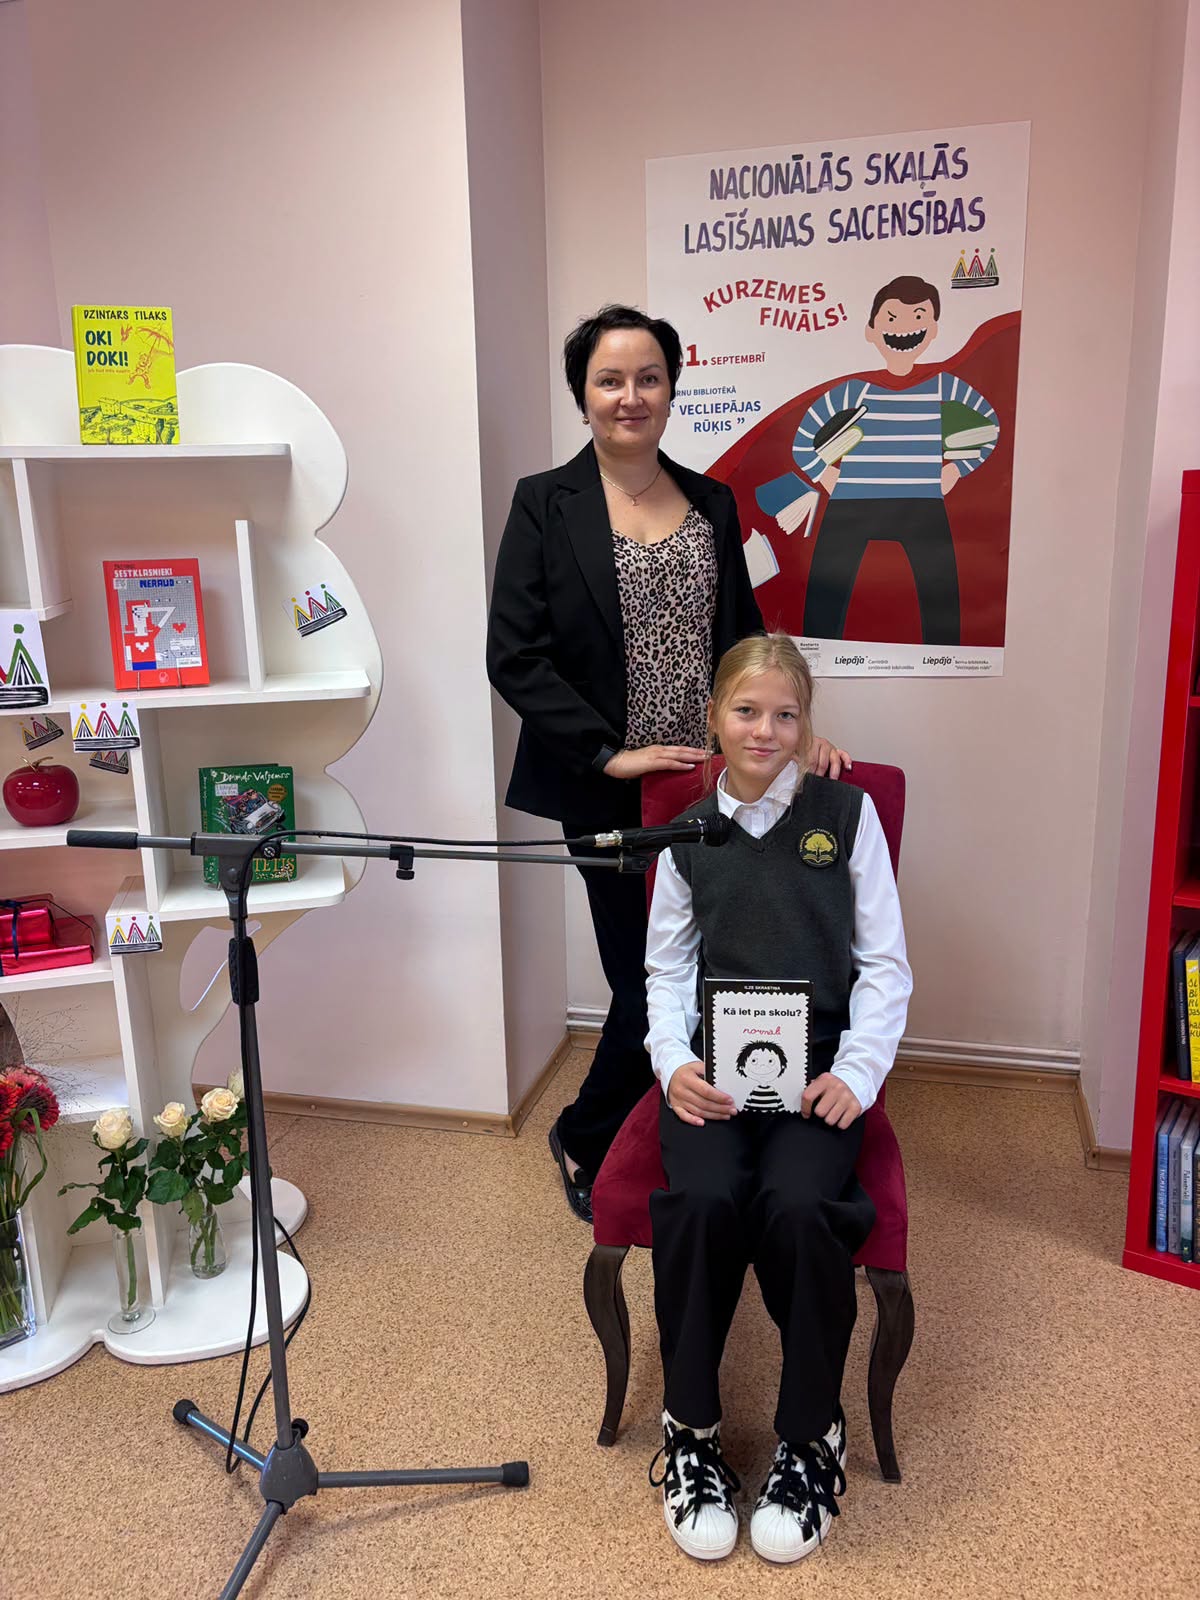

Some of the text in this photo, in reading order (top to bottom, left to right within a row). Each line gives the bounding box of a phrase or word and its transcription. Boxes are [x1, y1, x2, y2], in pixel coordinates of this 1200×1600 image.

[709, 142, 969, 201] NACIONĀLĀS SKAĻĀS
[684, 190, 986, 254] LASĪŠANAS SACENSĪBAS
[702, 278, 827, 313] KURZEMES
[83, 309, 167, 321] DZINTARS TILAKS
[759, 302, 848, 333] FINĀLS!
[85, 330, 112, 346] OKI
[86, 350, 129, 367] DOKI!
[679, 344, 766, 368] 1. SEPTEMBRĪ
[676, 385, 737, 397] RNU BIBLIOTĒKĀ
[723, 1007, 802, 1017] Kā iet pa skolu?
